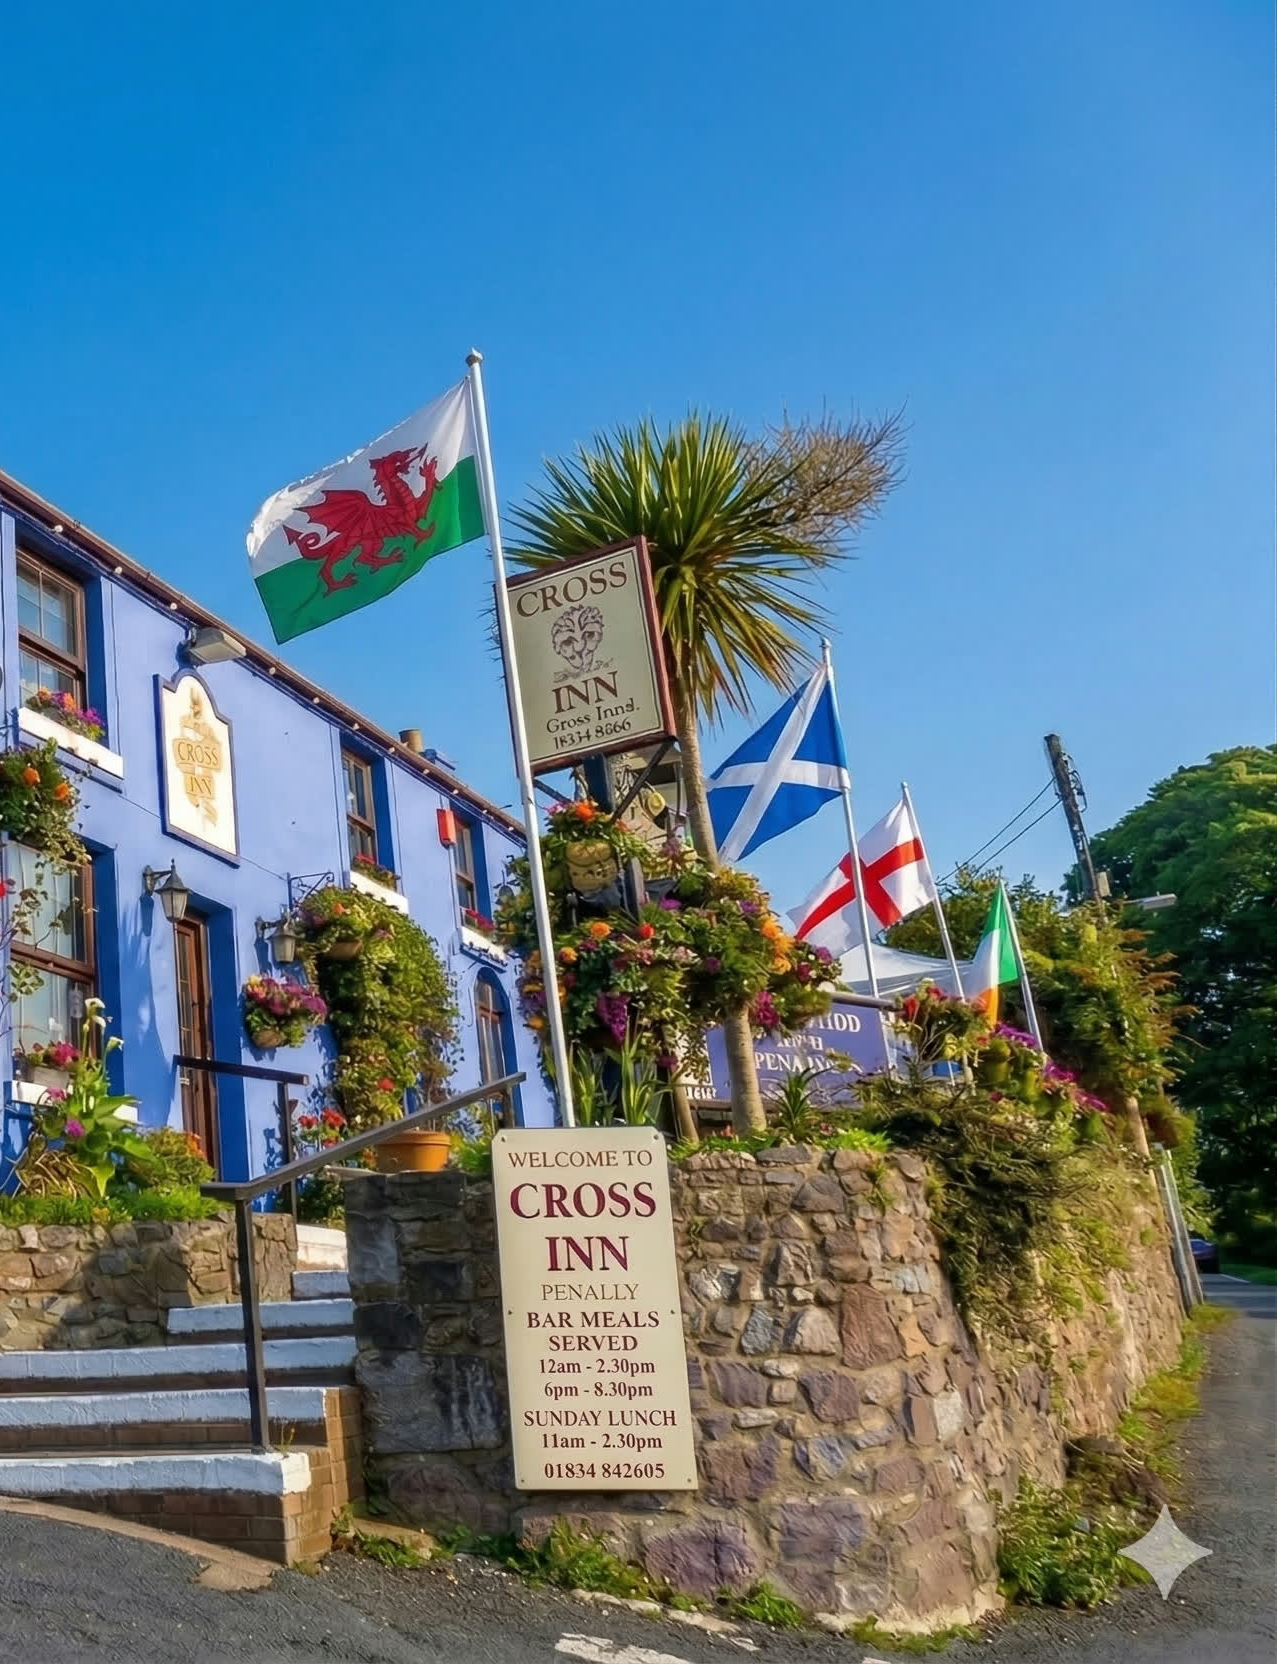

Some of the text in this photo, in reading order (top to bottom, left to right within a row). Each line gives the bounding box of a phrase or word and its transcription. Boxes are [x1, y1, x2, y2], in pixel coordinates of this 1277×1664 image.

[516, 561, 628, 618] CROSS
[551, 670, 619, 715] INN
[546, 714, 591, 734] Gross
[177, 741, 219, 767] CROSS
[189, 775, 212, 795] INN
[508, 1150, 653, 1168] WELCOME TO
[510, 1181, 657, 1219] CROSS
[545, 1236, 629, 1272] INN
[541, 1283, 639, 1301] PENALLY
[527, 1310, 660, 1329] BAR MEALS
[548, 1335, 638, 1352] SERVED
[539, 1359, 581, 1374] 12am
[595, 1358, 655, 1377] 2.30pm
[544, 1383, 579, 1400] 6pm
[594, 1381, 653, 1400] 8.30pm
[524, 1410, 678, 1427] SUNDAY LUNCH
[542, 1433, 585, 1449] 11am
[602, 1433, 663, 1452] 2.30pm
[544, 1463, 665, 1479] 01834 842605
